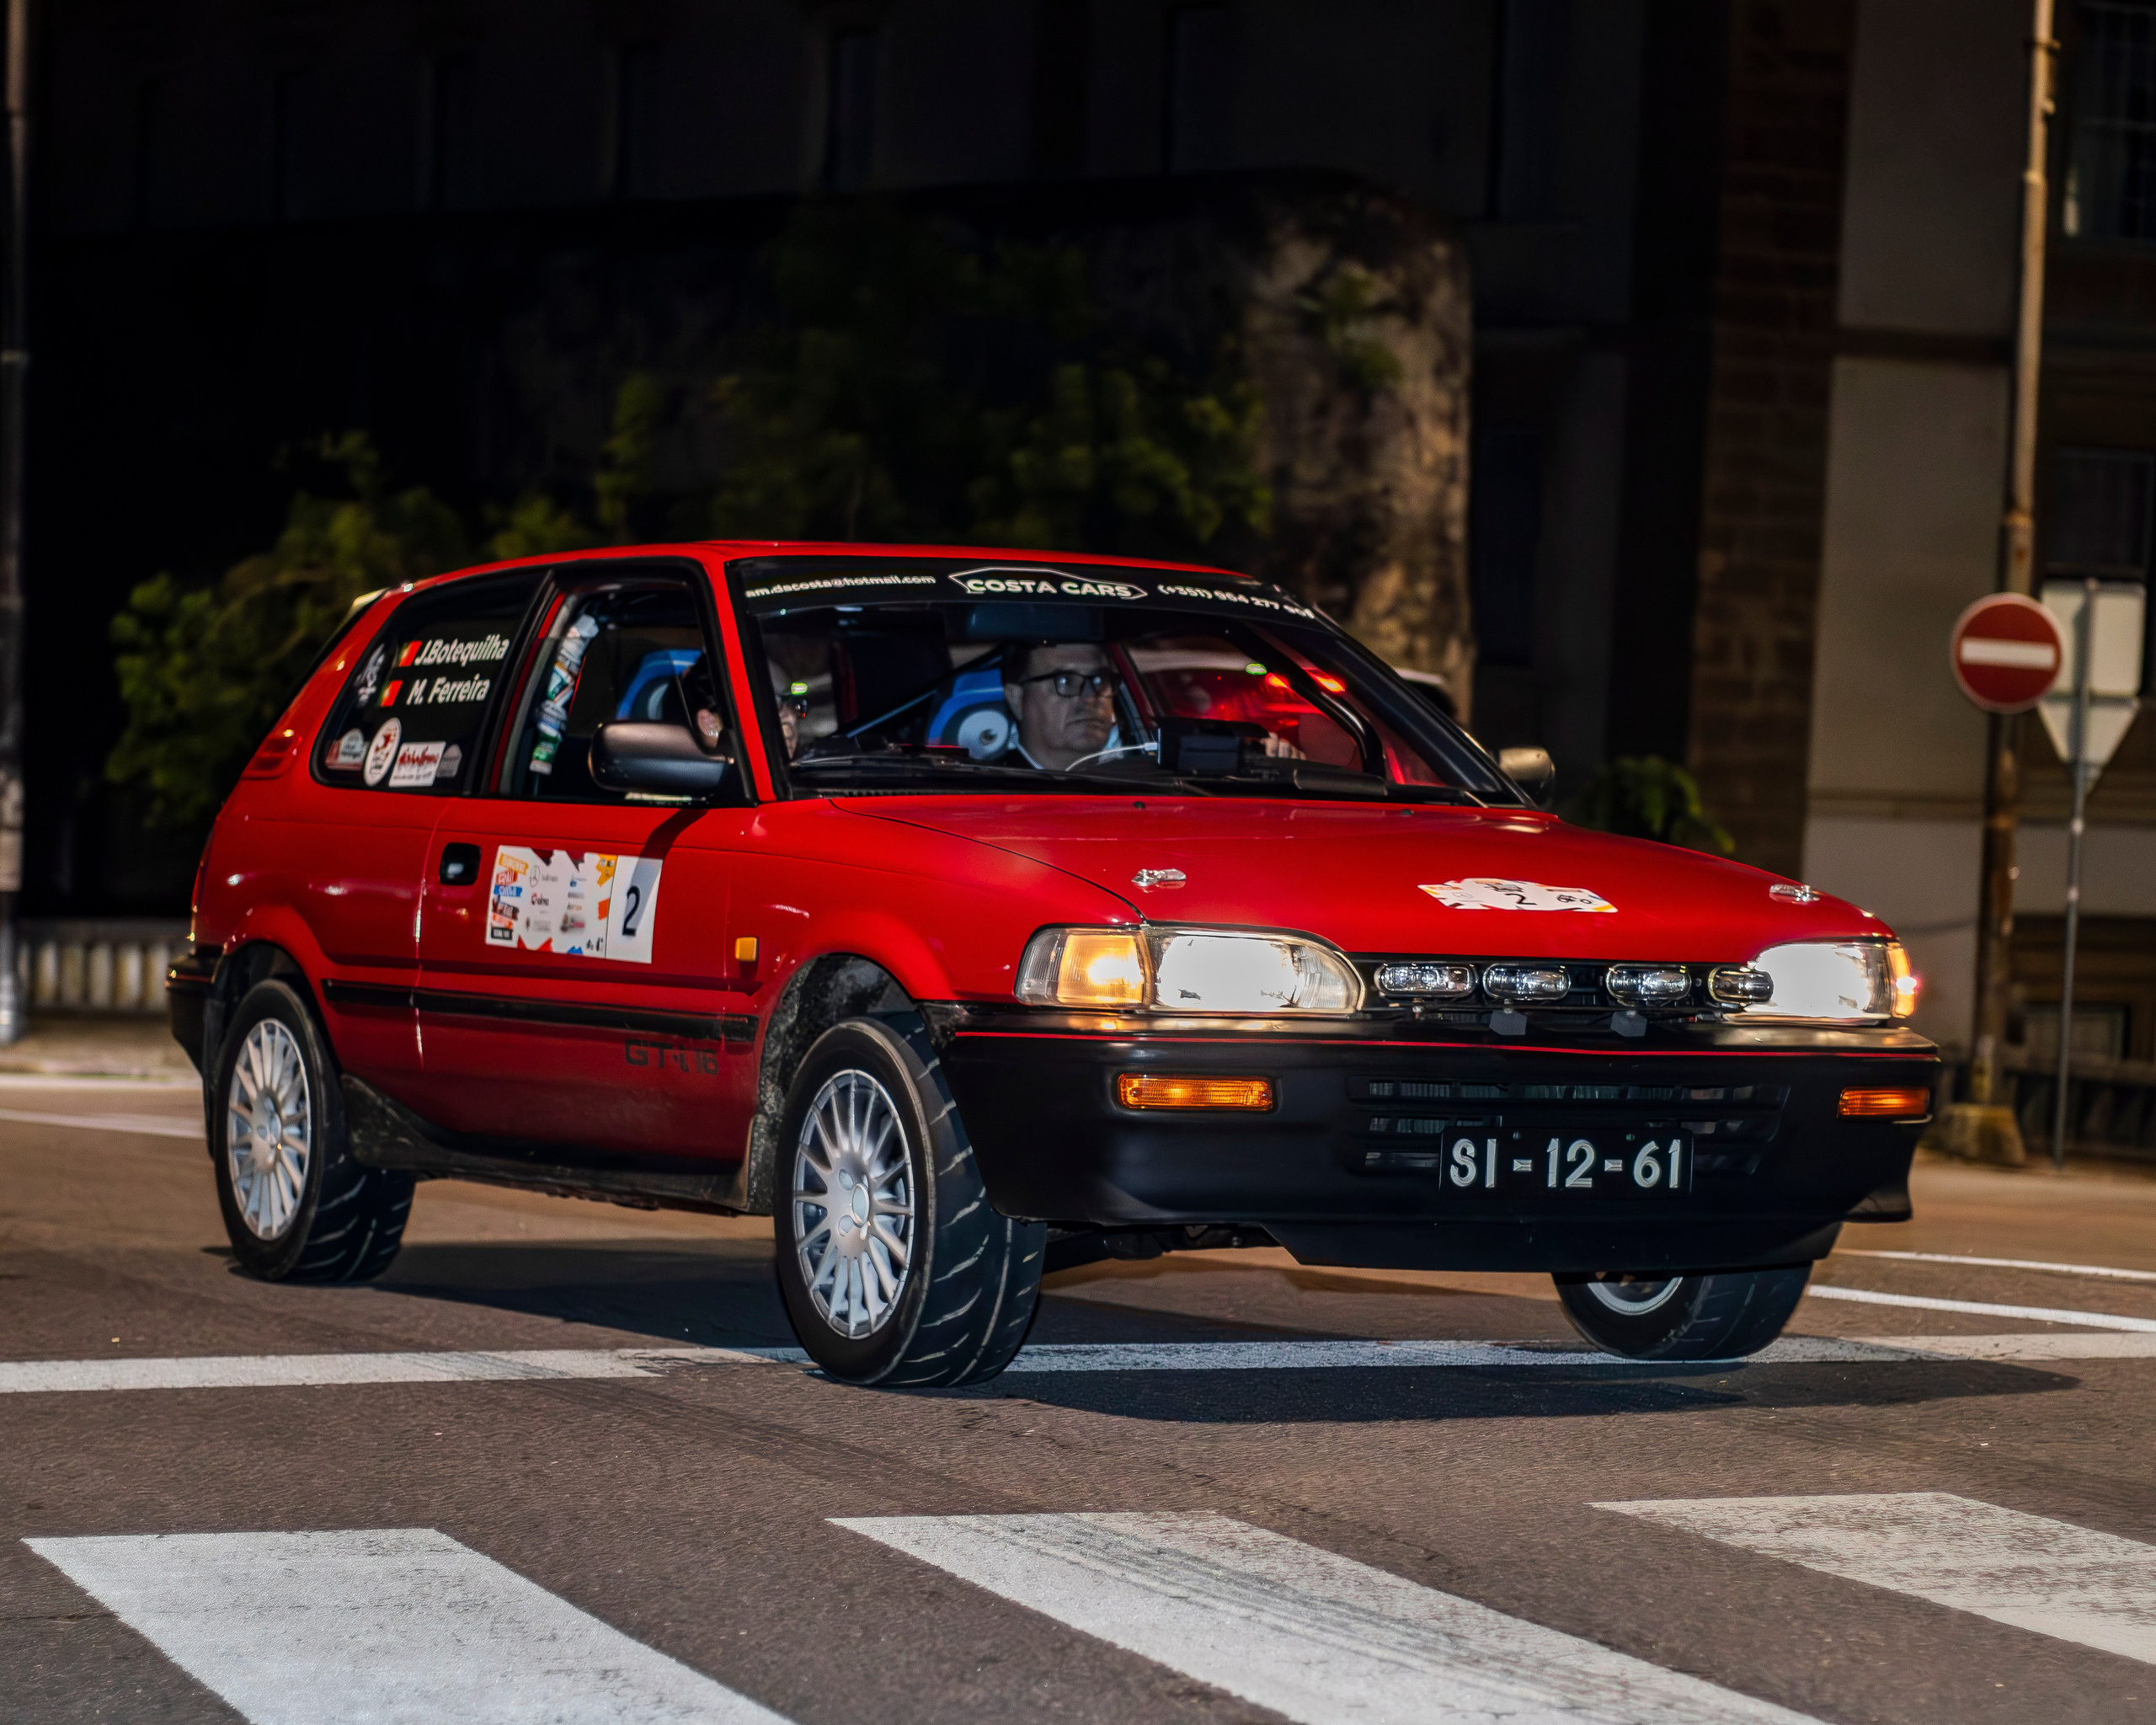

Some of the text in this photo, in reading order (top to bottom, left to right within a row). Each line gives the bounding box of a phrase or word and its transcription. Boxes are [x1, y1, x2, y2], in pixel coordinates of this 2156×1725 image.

[966, 579, 1131, 597] COSTA CARS
[414, 633, 510, 667] J.Botequilha
[406, 673, 490, 705] M. Ferreira
[622, 885, 641, 937] 2
[1504, 893, 1537, 905] 2
